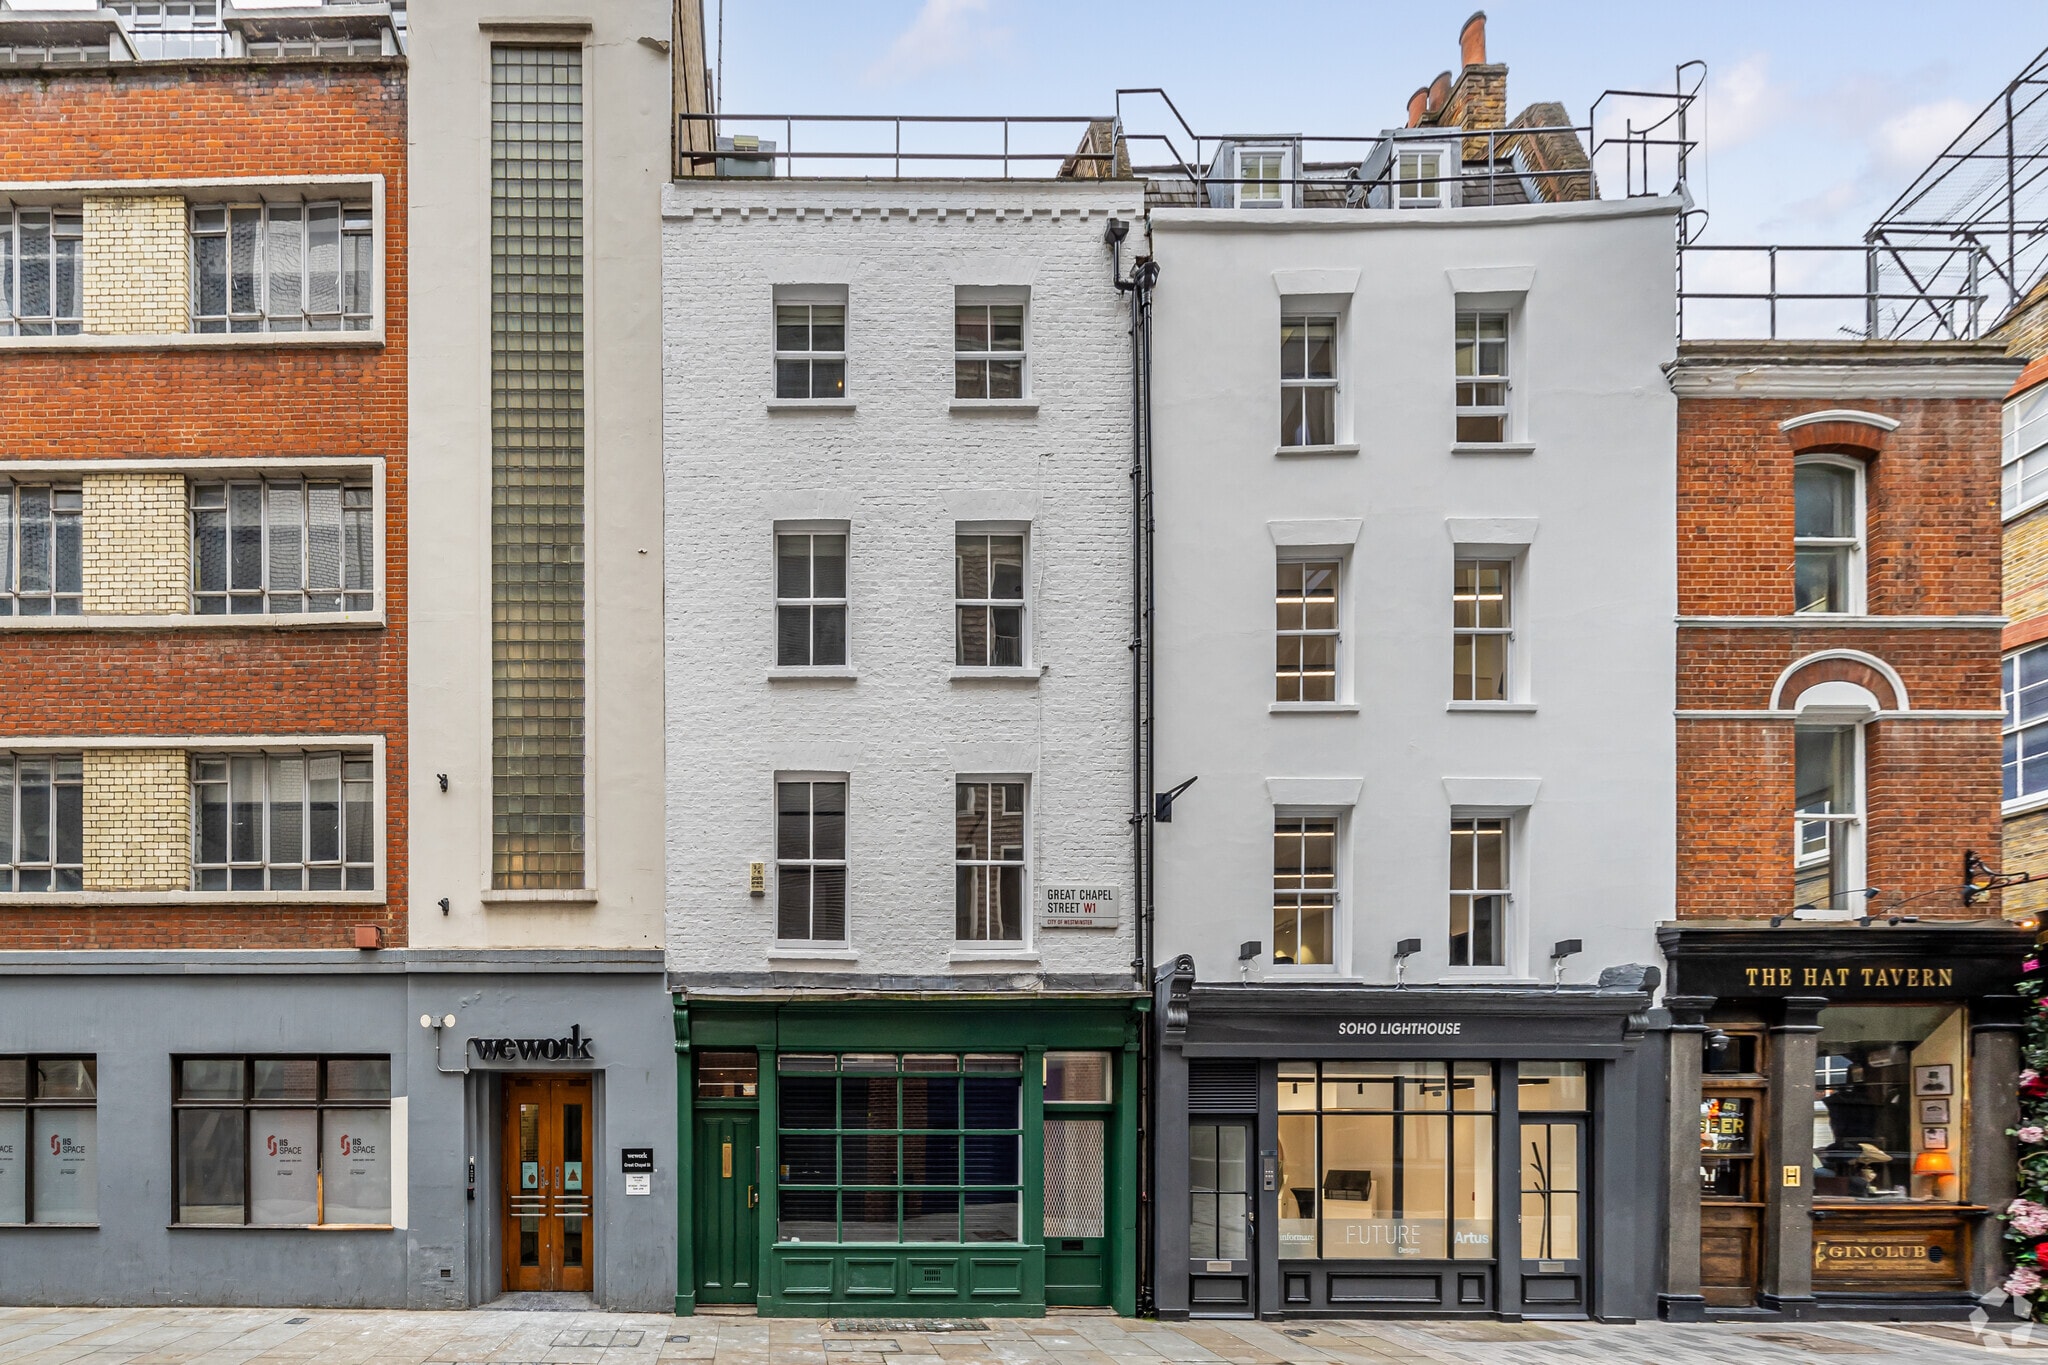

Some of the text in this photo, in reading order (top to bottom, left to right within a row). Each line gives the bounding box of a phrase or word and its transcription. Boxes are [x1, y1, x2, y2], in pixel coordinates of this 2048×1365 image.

[1047, 889, 1113, 901] GREAT CHAPEL
[1047, 902, 1096, 914] STREET W1
[1745, 967, 1953, 987] THE HAT TAVERN
[1338, 1022, 1461, 1035] SOHO LIGHTHOUSE
[471, 1023, 595, 1061] wework
[62, 1138, 72, 1146] IIS
[62, 1146, 85, 1154] SPACE
[279, 1147, 302, 1155] SPACE
[352, 1146, 375, 1154] SPACE
[1346, 1225, 1420, 1244] FUTURE
[1454, 1231, 1489, 1244] Artus
[1828, 1245, 1927, 1258] GIN CLUB
